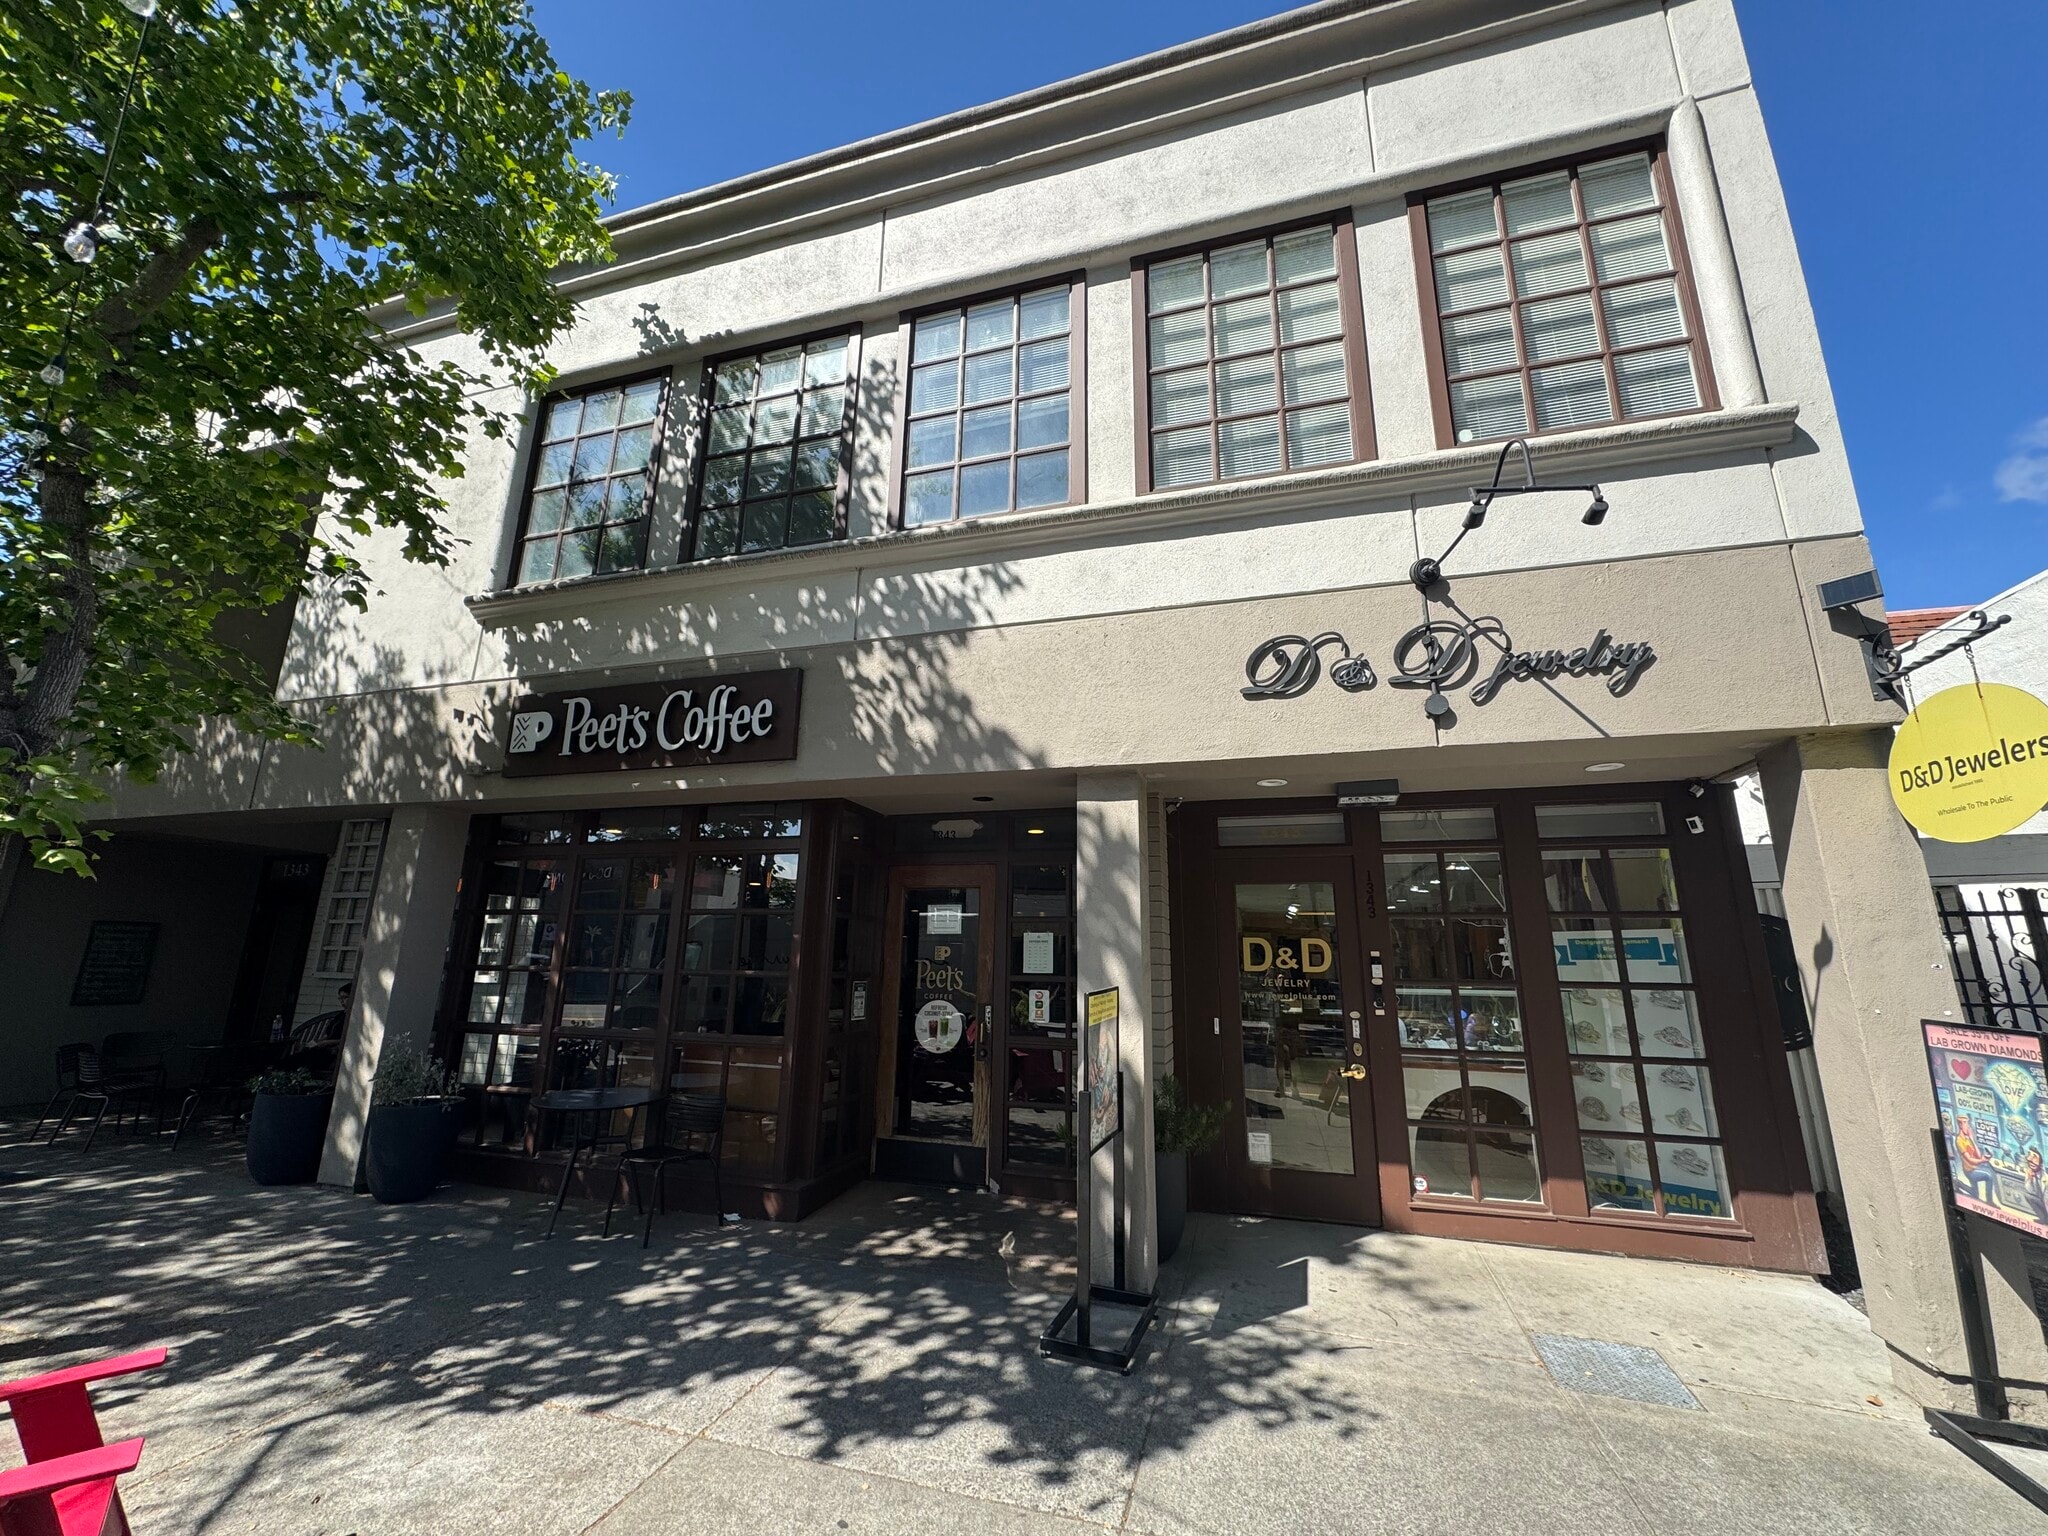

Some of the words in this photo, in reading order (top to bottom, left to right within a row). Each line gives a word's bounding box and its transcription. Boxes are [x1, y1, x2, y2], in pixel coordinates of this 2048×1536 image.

[1240, 631, 1345, 696] D
[1388, 616, 1505, 683] D
[558, 697, 650, 756] Peet's
[656, 684, 773, 754] Coffee
[1900, 759, 1943, 793] D&D
[1937, 804, 1966, 817] Wholesale
[1967, 802, 1976, 811] To
[1976, 799, 1989, 809] The
[1990, 794, 2013, 806] Public
[282, 863, 310, 877] 1343
[1365, 869, 1377, 919] 1343
[1242, 936, 1332, 973] D&D
[1605, 938, 1649, 946] Engement
[914, 958, 964, 992] Peet's
[1261, 978, 1311, 988] JEWELRY
[923, 992, 953, 1001] COFFEE
[1930, 1036, 1949, 1047] LAB
[1951, 1039, 1987, 1053] GROWN
[1989, 1044, 2043, 1062] DIAMONDS
[1976, 1122, 1996, 1132] LOVE
[1635, 1184, 1722, 1216] Jewelry
